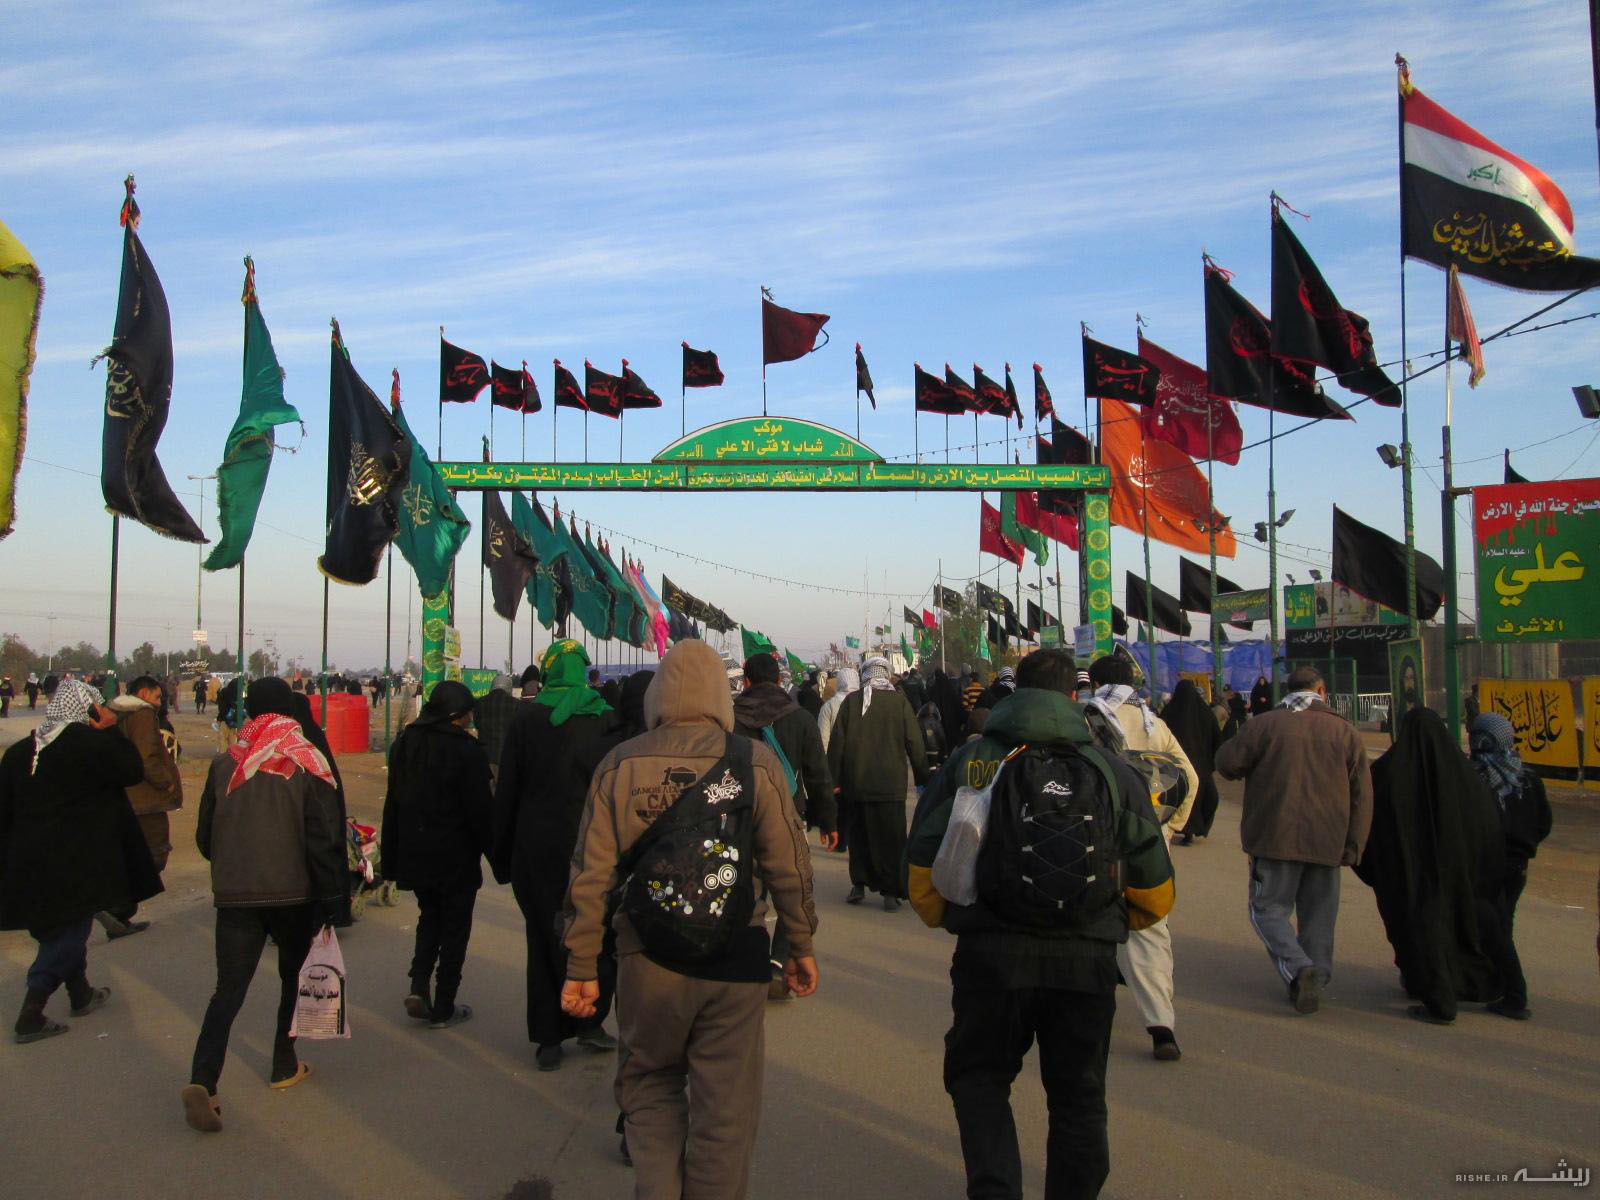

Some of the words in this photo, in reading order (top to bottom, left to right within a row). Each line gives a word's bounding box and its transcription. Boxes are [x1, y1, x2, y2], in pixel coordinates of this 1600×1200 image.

[753, 420, 783, 436] موكب
[716, 440, 738, 458] علي
[756, 438, 779, 455] فتى
[780, 440, 790, 452] لا
[792, 437, 823, 456] شباب
[965, 469, 989, 485] بين
[991, 468, 1035, 485] المتصل
[1037, 468, 1080, 486] السبب
[1514, 499, 1527, 521] في
[1530, 499, 1546, 513] الله
[1550, 497, 1569, 515] جنة
[1494, 542, 1585, 607] علي
